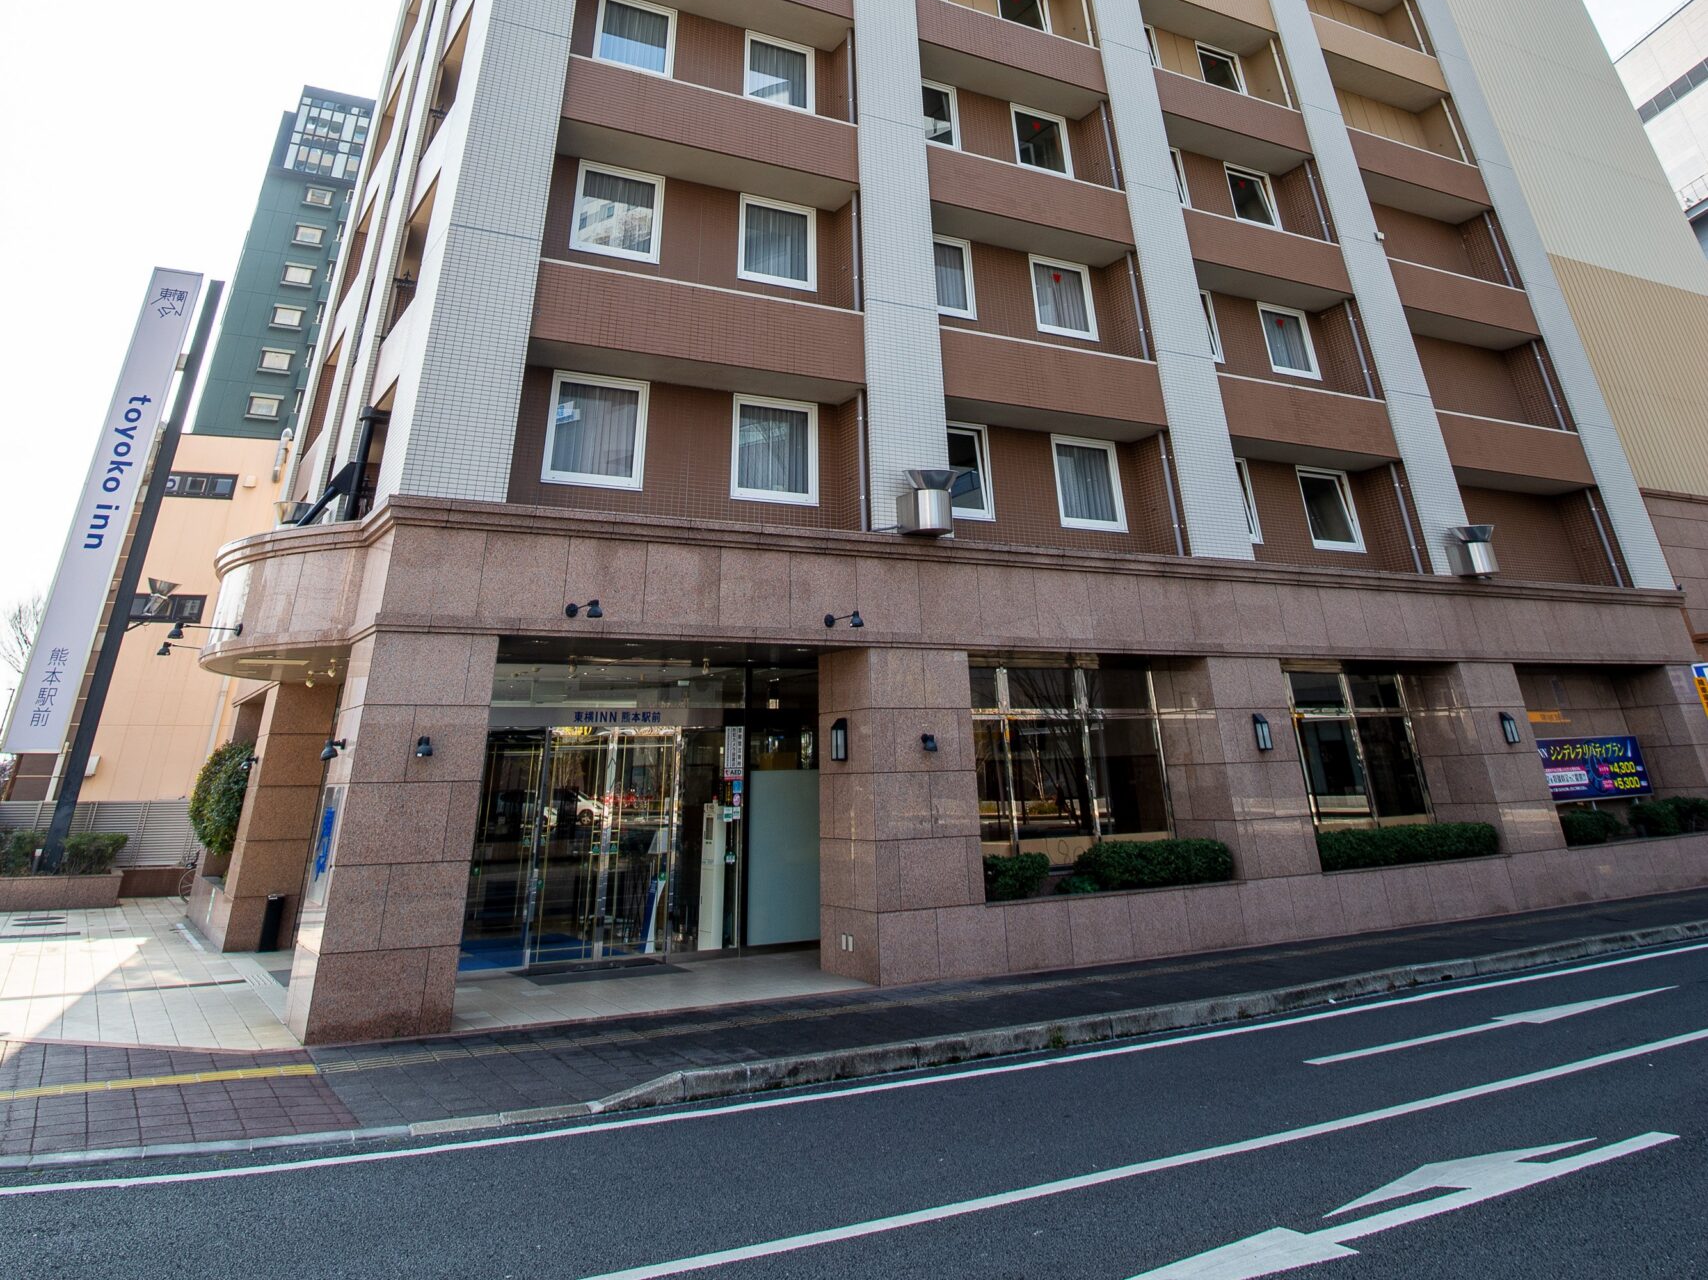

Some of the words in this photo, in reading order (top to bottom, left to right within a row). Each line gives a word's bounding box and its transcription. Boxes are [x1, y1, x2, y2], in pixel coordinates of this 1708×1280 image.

[102, 395, 152, 493] toyoko
[84, 504, 120, 549] inn
[30, 647, 70, 727] 熊本駅前
[621, 711, 661, 723] 熊本駅前
